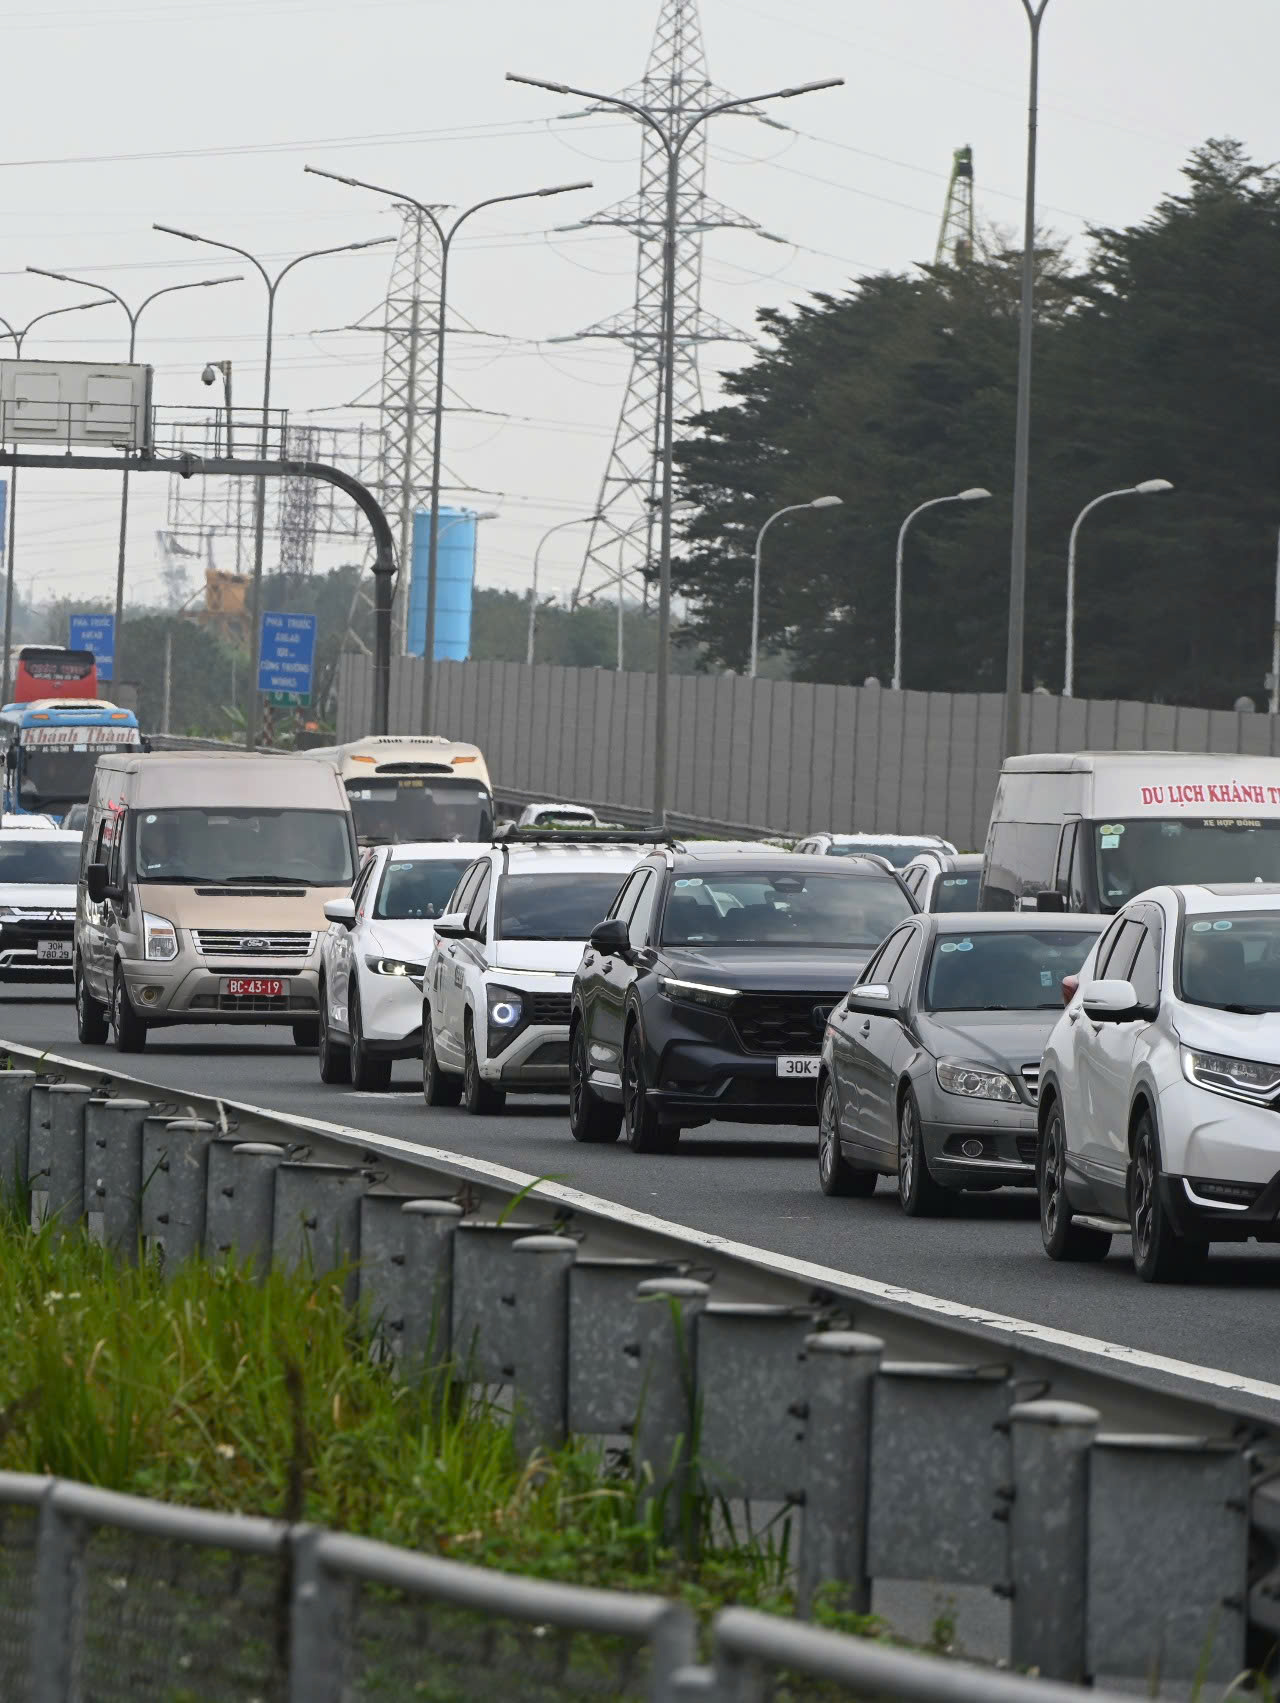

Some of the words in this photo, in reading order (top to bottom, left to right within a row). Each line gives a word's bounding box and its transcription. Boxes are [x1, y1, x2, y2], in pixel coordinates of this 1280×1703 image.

[23, 727, 78, 743] Khánh
[87, 727, 136, 743] Thành
[1141, 787, 1164, 805] DU
[1168, 785, 1204, 807] LỊCH
[1203, 819, 1215, 827] XE
[1217, 819, 1235, 828] HỢP
[47, 942, 64, 950] 30H
[247, 939, 264, 948] Ford
[230, 980, 280, 993] BC-43-19
[786, 1060, 821, 1074] 30K-
